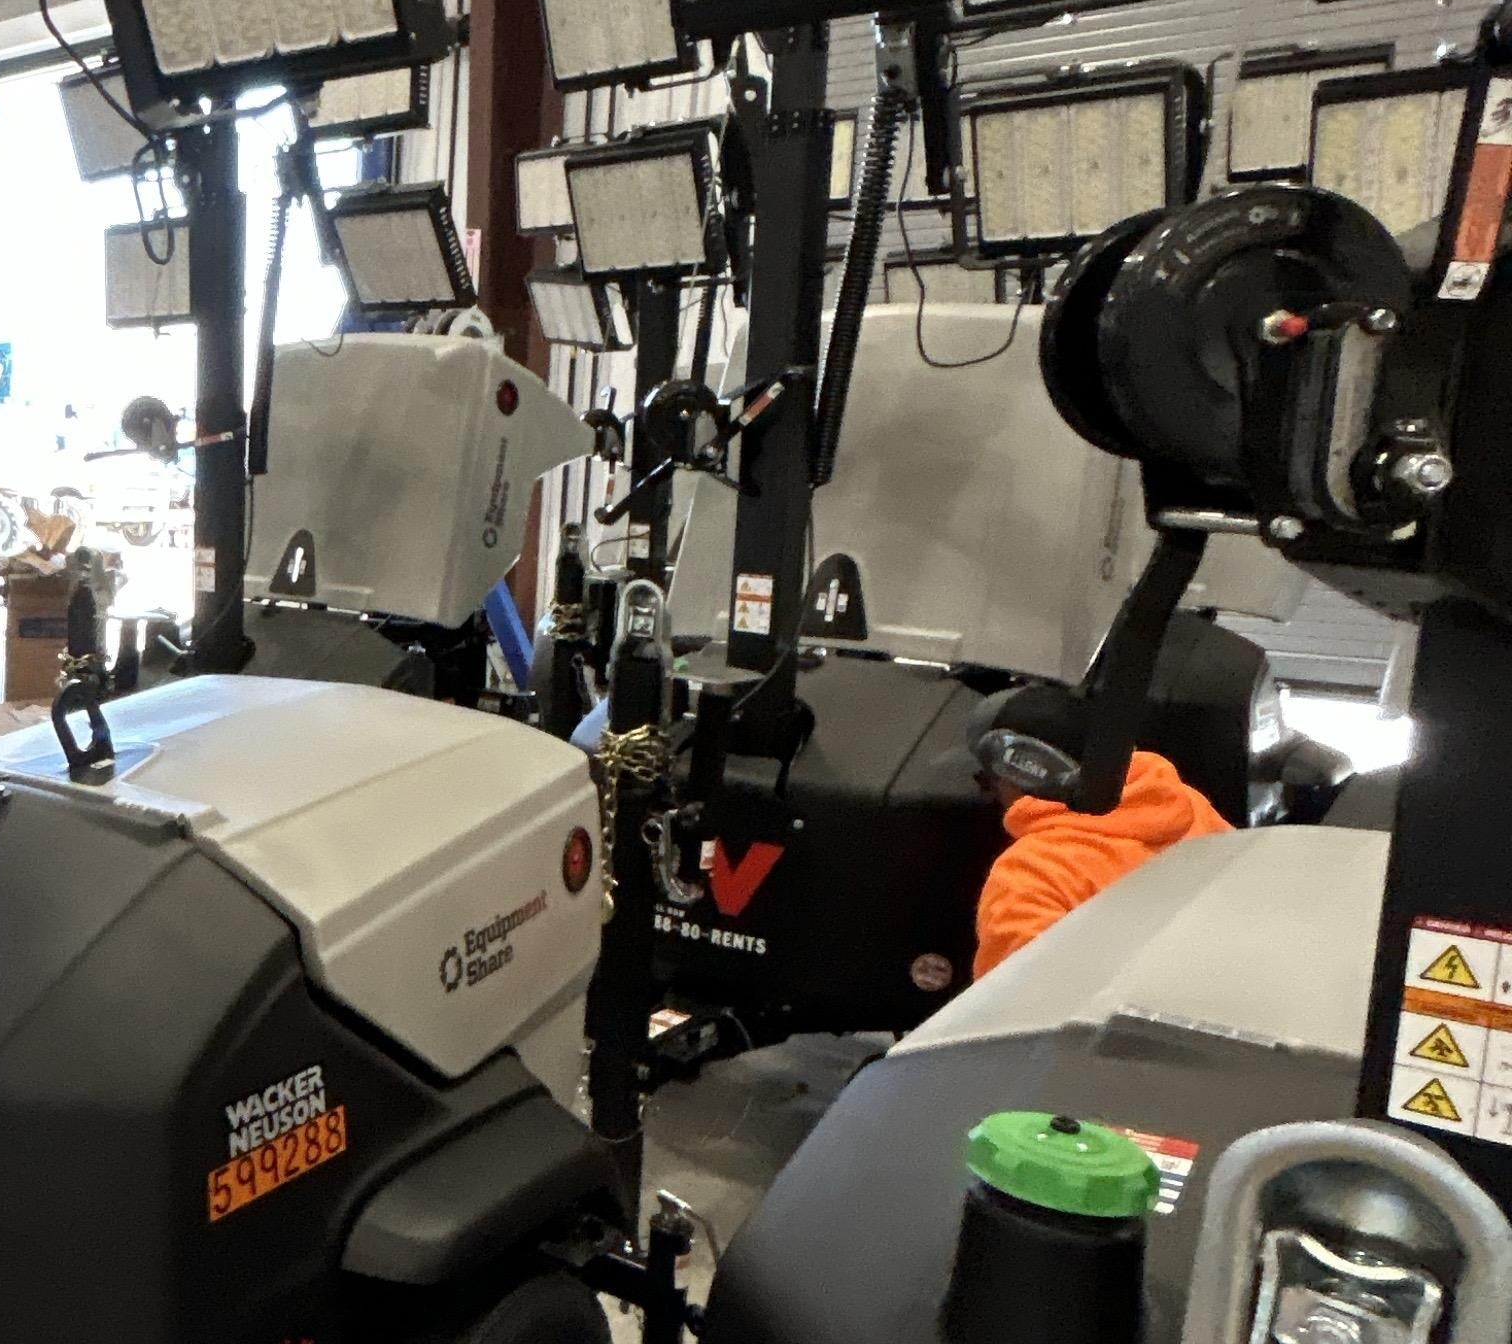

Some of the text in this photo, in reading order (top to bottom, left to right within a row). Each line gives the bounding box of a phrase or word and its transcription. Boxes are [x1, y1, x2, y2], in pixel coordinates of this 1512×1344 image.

[462, 889, 548, 957] Equipment
[466, 944, 514, 987] Share
[225, 1064, 325, 1130] WACKER
[229, 1089, 327, 1159] NEUSON
[212, 1111, 342, 1214] 599288
